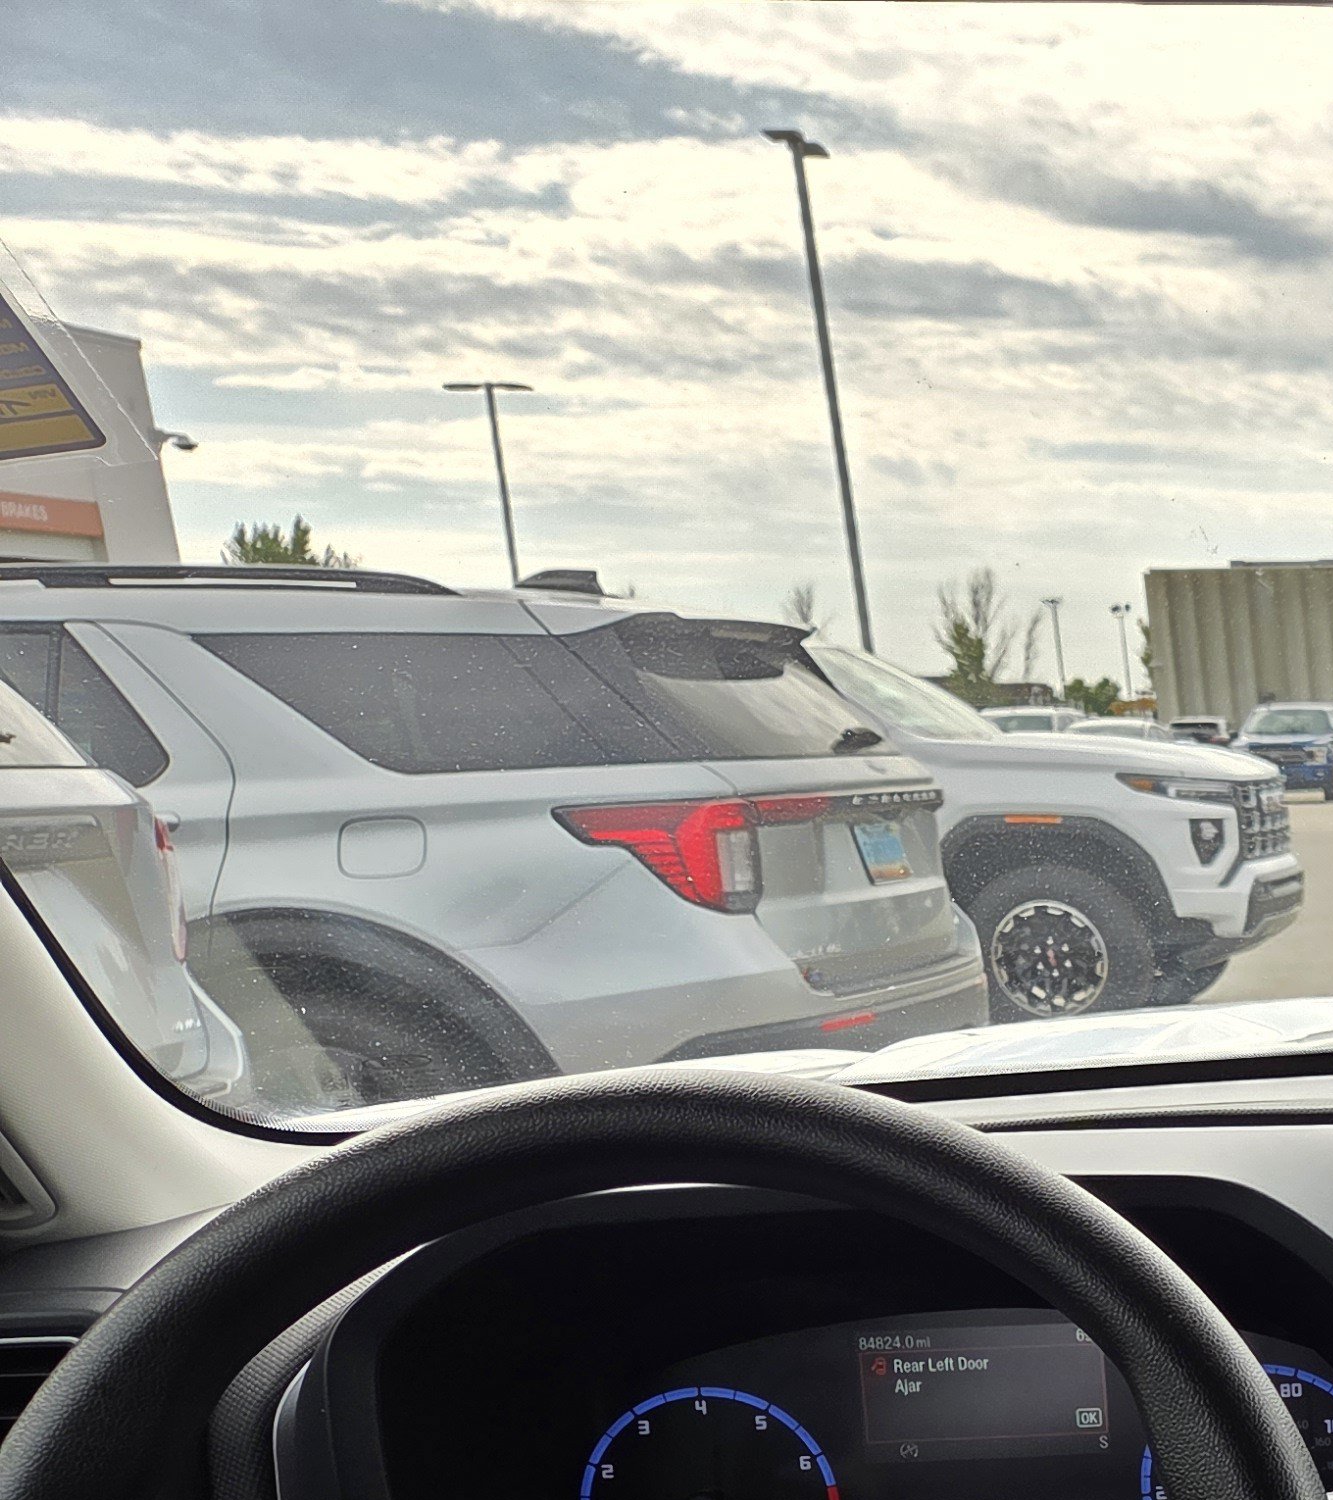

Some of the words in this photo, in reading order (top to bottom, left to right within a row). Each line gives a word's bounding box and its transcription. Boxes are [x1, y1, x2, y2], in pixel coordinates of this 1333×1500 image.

[0, 501, 48, 521] BRAKES
[893, 1357, 925, 1374] Rear
[927, 1356, 954, 1372] Left
[957, 1356, 989, 1371] Door
[895, 1378, 922, 1396] Ajar
[1280, 1382, 1302, 1398] 80
[694, 1400, 707, 1415] 4
[754, 1415, 768, 1431] 5
[1080, 1411, 1099, 1425] OK
[637, 1420, 651, 1436] 3
[1099, 1434, 1109, 1449] S
[798, 1455, 812, 1471] 6
[601, 1464, 615, 1479] 2
